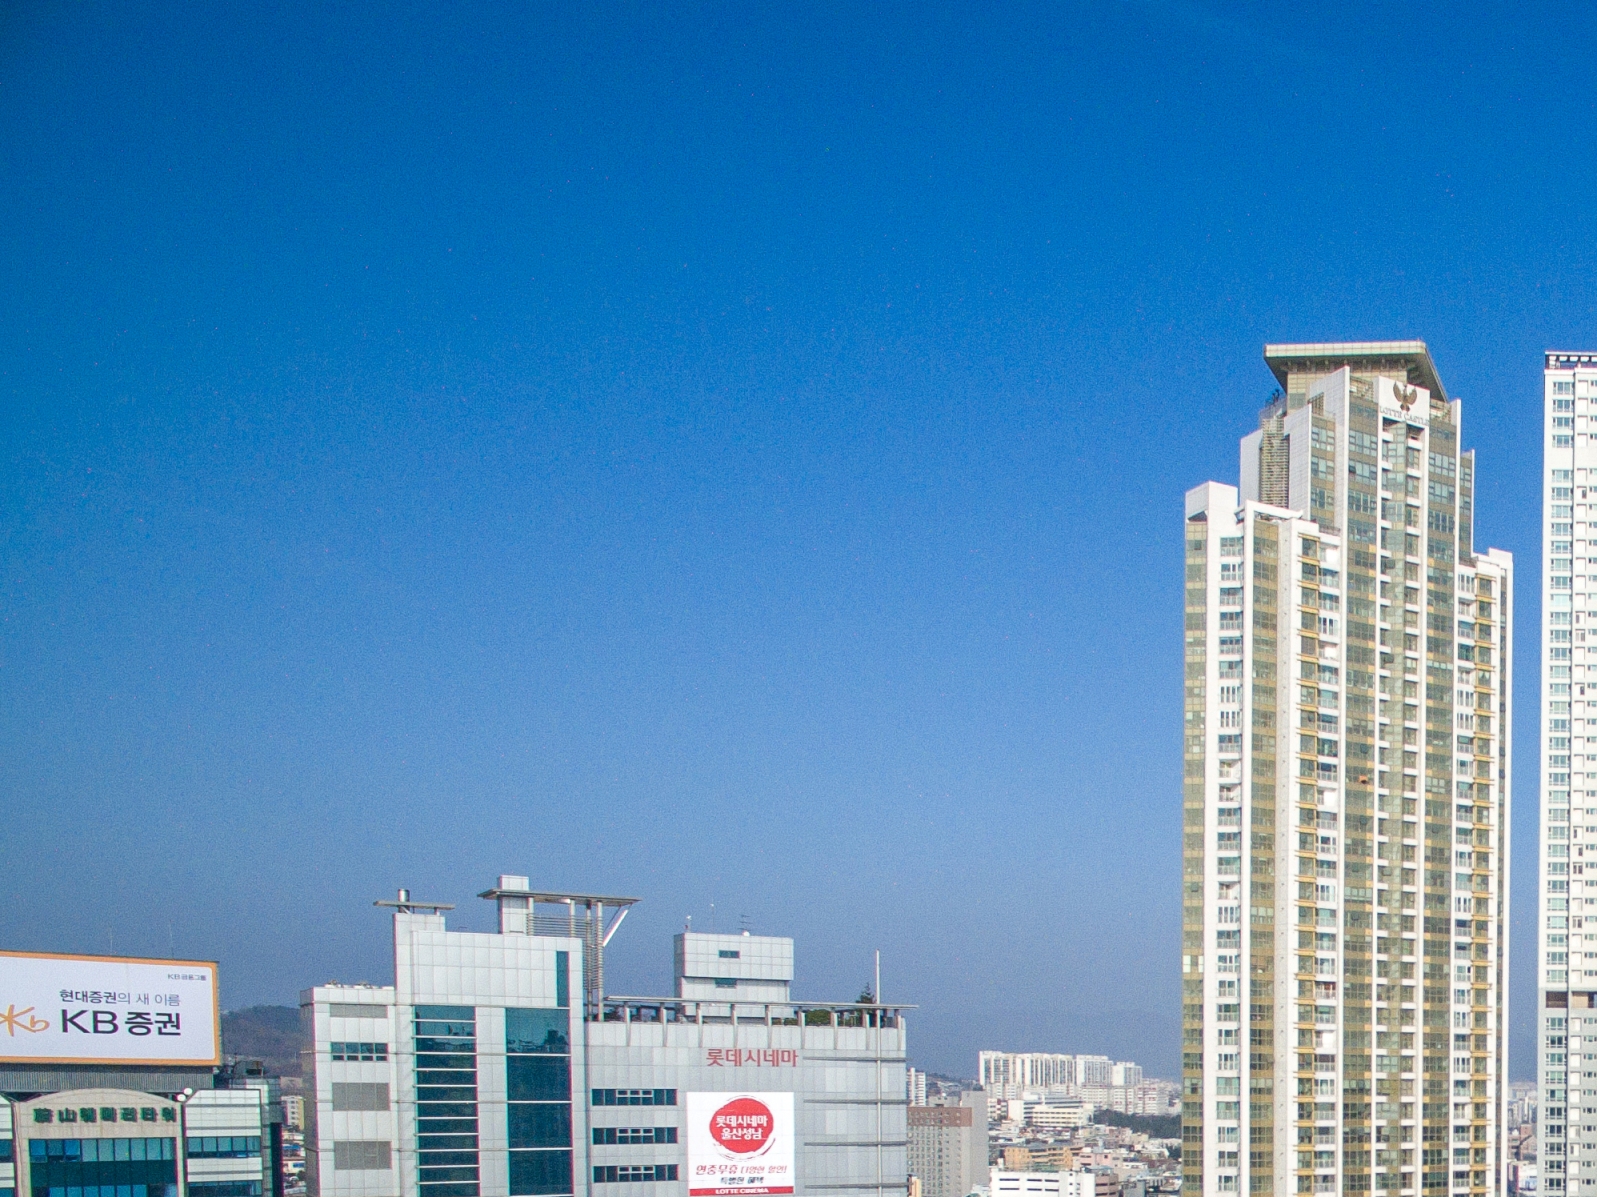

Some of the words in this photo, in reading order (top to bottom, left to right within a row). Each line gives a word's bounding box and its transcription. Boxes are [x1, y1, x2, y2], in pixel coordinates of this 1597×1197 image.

[59, 989, 131, 1005] 현대증권의
[136, 993, 150, 1006] 새
[154, 993, 182, 1007] 이름
[61, 1009, 119, 1034] KB
[125, 1012, 182, 1036] 증권
[706, 1048, 799, 1068] 롯데시네마
[715, 1115, 768, 1127] 롯데시네마
[721, 1128, 763, 1141] 울산성남
[696, 1165, 738, 1176] 연중무휴
